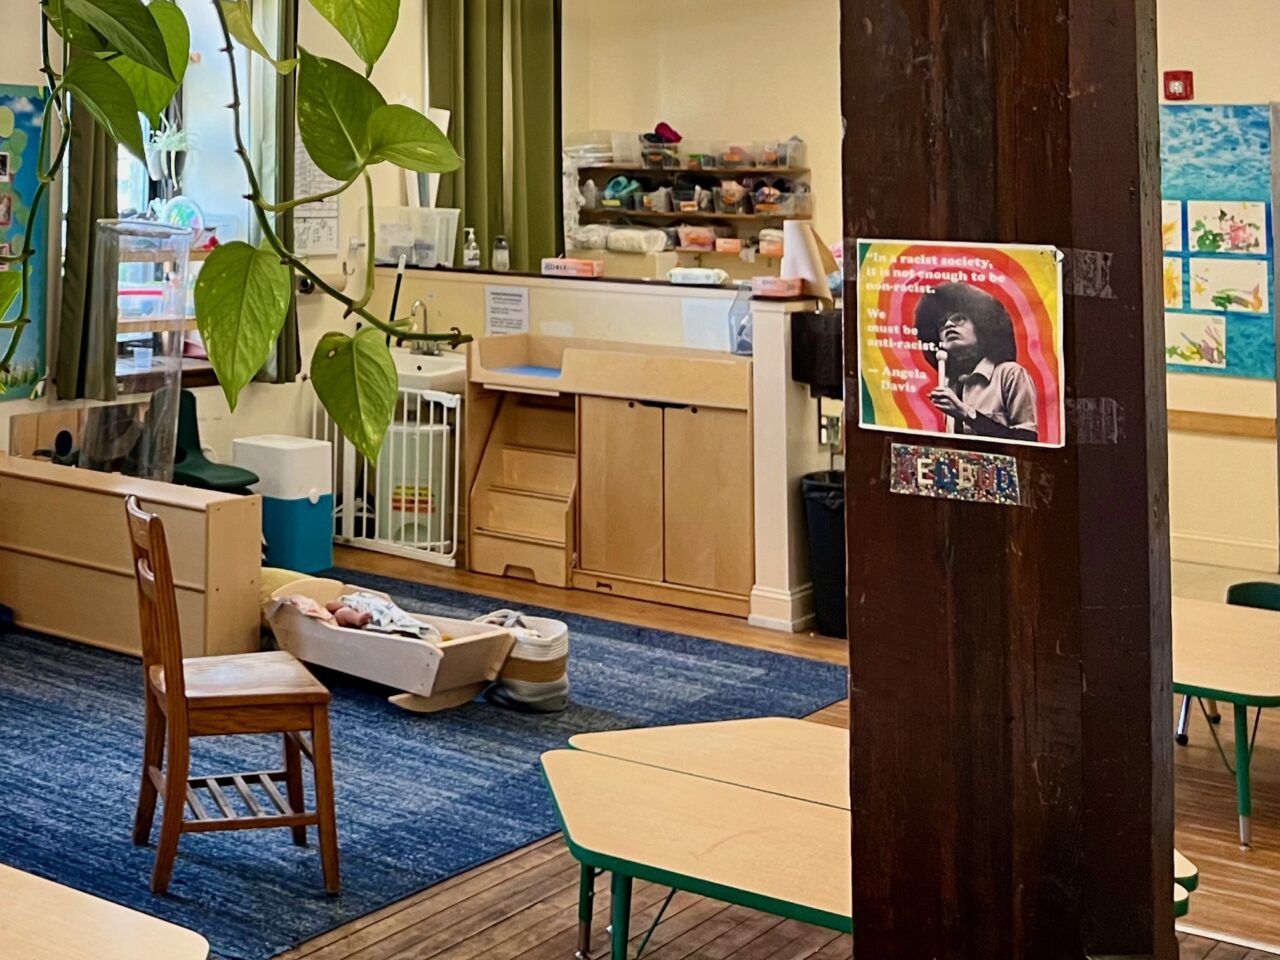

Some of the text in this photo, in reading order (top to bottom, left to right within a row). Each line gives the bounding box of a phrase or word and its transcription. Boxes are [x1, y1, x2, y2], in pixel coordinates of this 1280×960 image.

[900, 254, 938, 265] racist
[941, 255, 994, 270] society,
[866, 266, 1006, 283] it is not enough to be
[866, 281, 936, 294] non-racist.
[867, 308, 887, 319] We
[867, 324, 919, 336] must be
[882, 366, 927, 380] Angela
[881, 380, 917, 393] Davis
